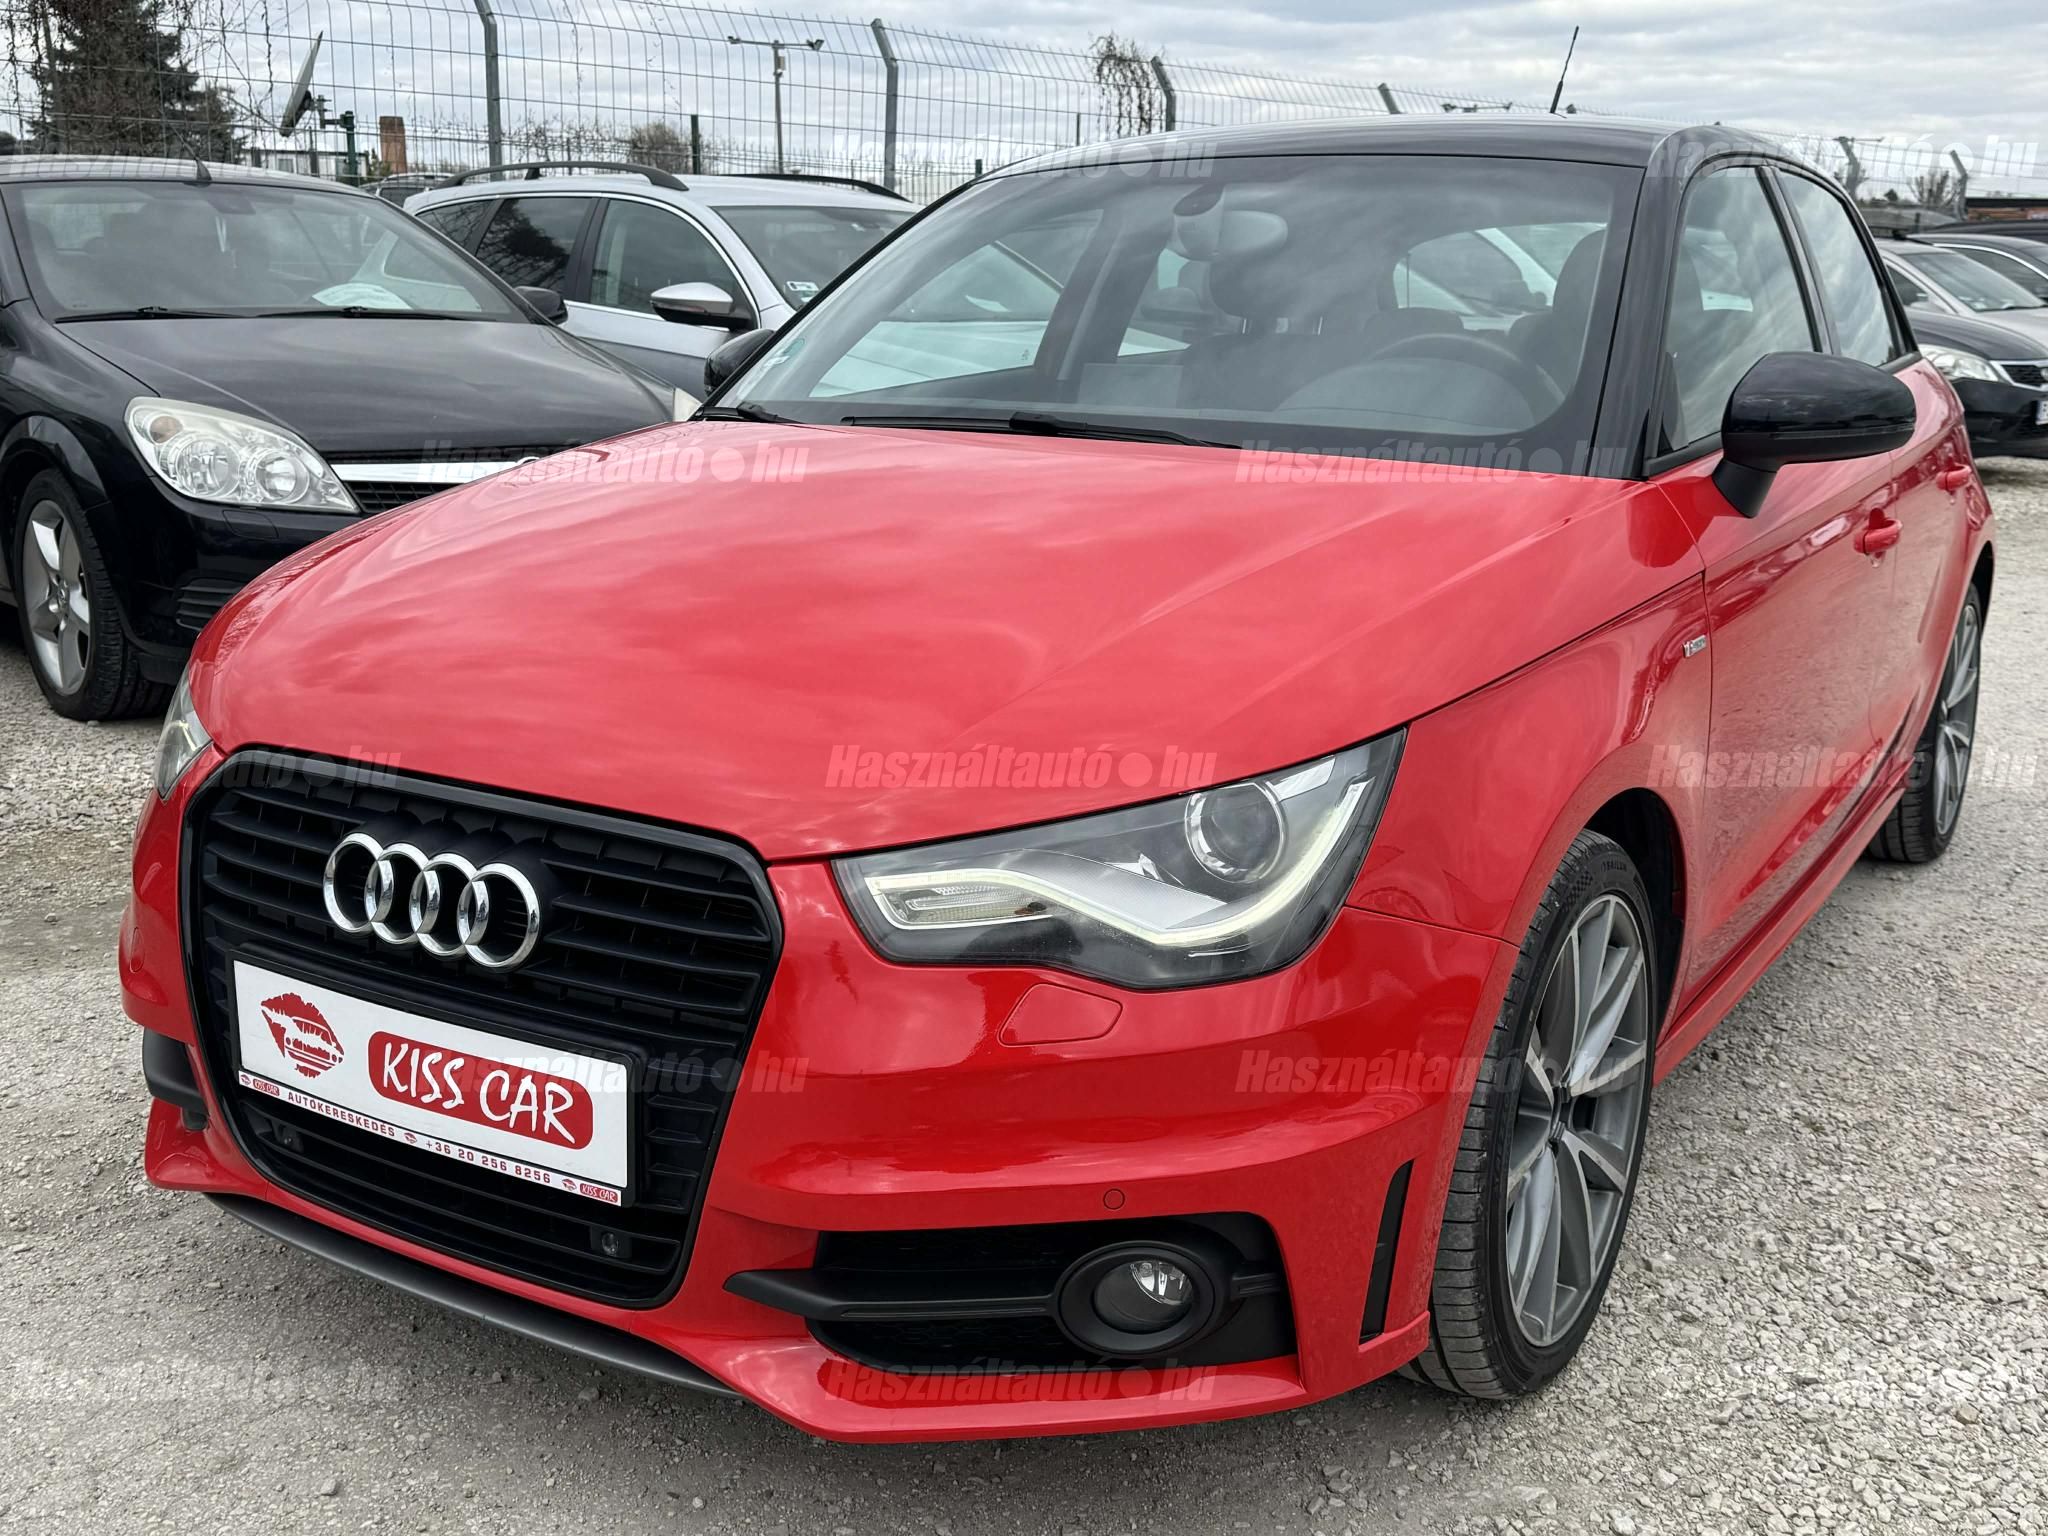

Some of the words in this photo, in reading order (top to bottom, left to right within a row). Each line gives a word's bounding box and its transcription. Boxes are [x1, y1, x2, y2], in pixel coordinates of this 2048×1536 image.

[383, 1042, 465, 1109] KISS
[479, 1069, 576, 1144] CAR
[426, 1141, 451, 1155] +36
[458, 1148, 475, 1162] 20
[481, 1155, 507, 1172] 256
[514, 1165, 551, 1184] 8256
[581, 1184, 598, 1197] KISS
[599, 1188, 616, 1202] CAR
